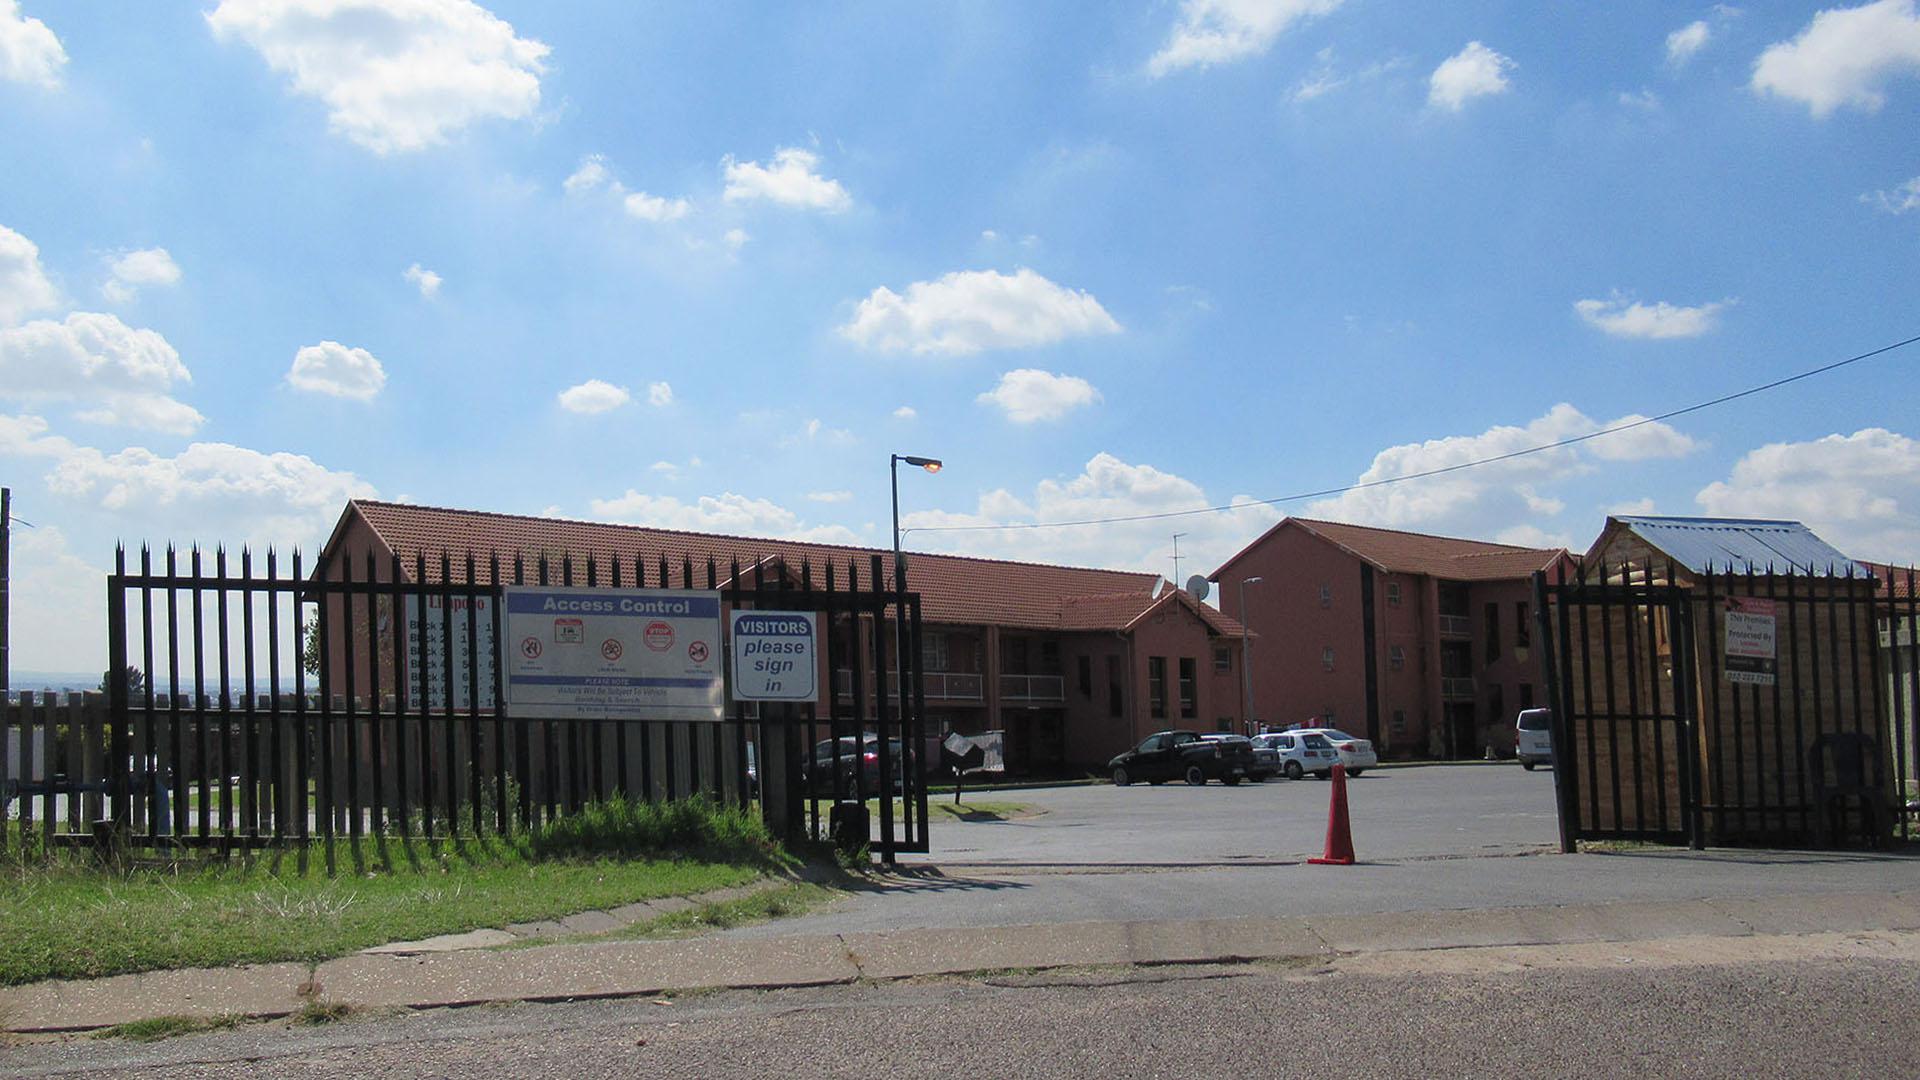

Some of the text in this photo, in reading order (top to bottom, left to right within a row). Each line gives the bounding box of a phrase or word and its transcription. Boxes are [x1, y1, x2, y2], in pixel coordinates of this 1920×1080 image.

[429, 594, 485, 612] Lipoo
[544, 597, 690, 614] Access Control
[410, 621, 436, 630] Bck
[740, 621, 808, 634] VISITORS
[410, 633, 436, 643] Bck
[1729, 630, 1761, 640] Protected
[411, 647, 436, 655] Bck
[744, 640, 804, 657] please
[411, 659, 437, 668] Bck
[754, 657, 793, 675] sign
[411, 673, 438, 681] Bck
[412, 686, 438, 694] Bck
[765, 678, 782, 692] in
[412, 699, 438, 707] Bck
